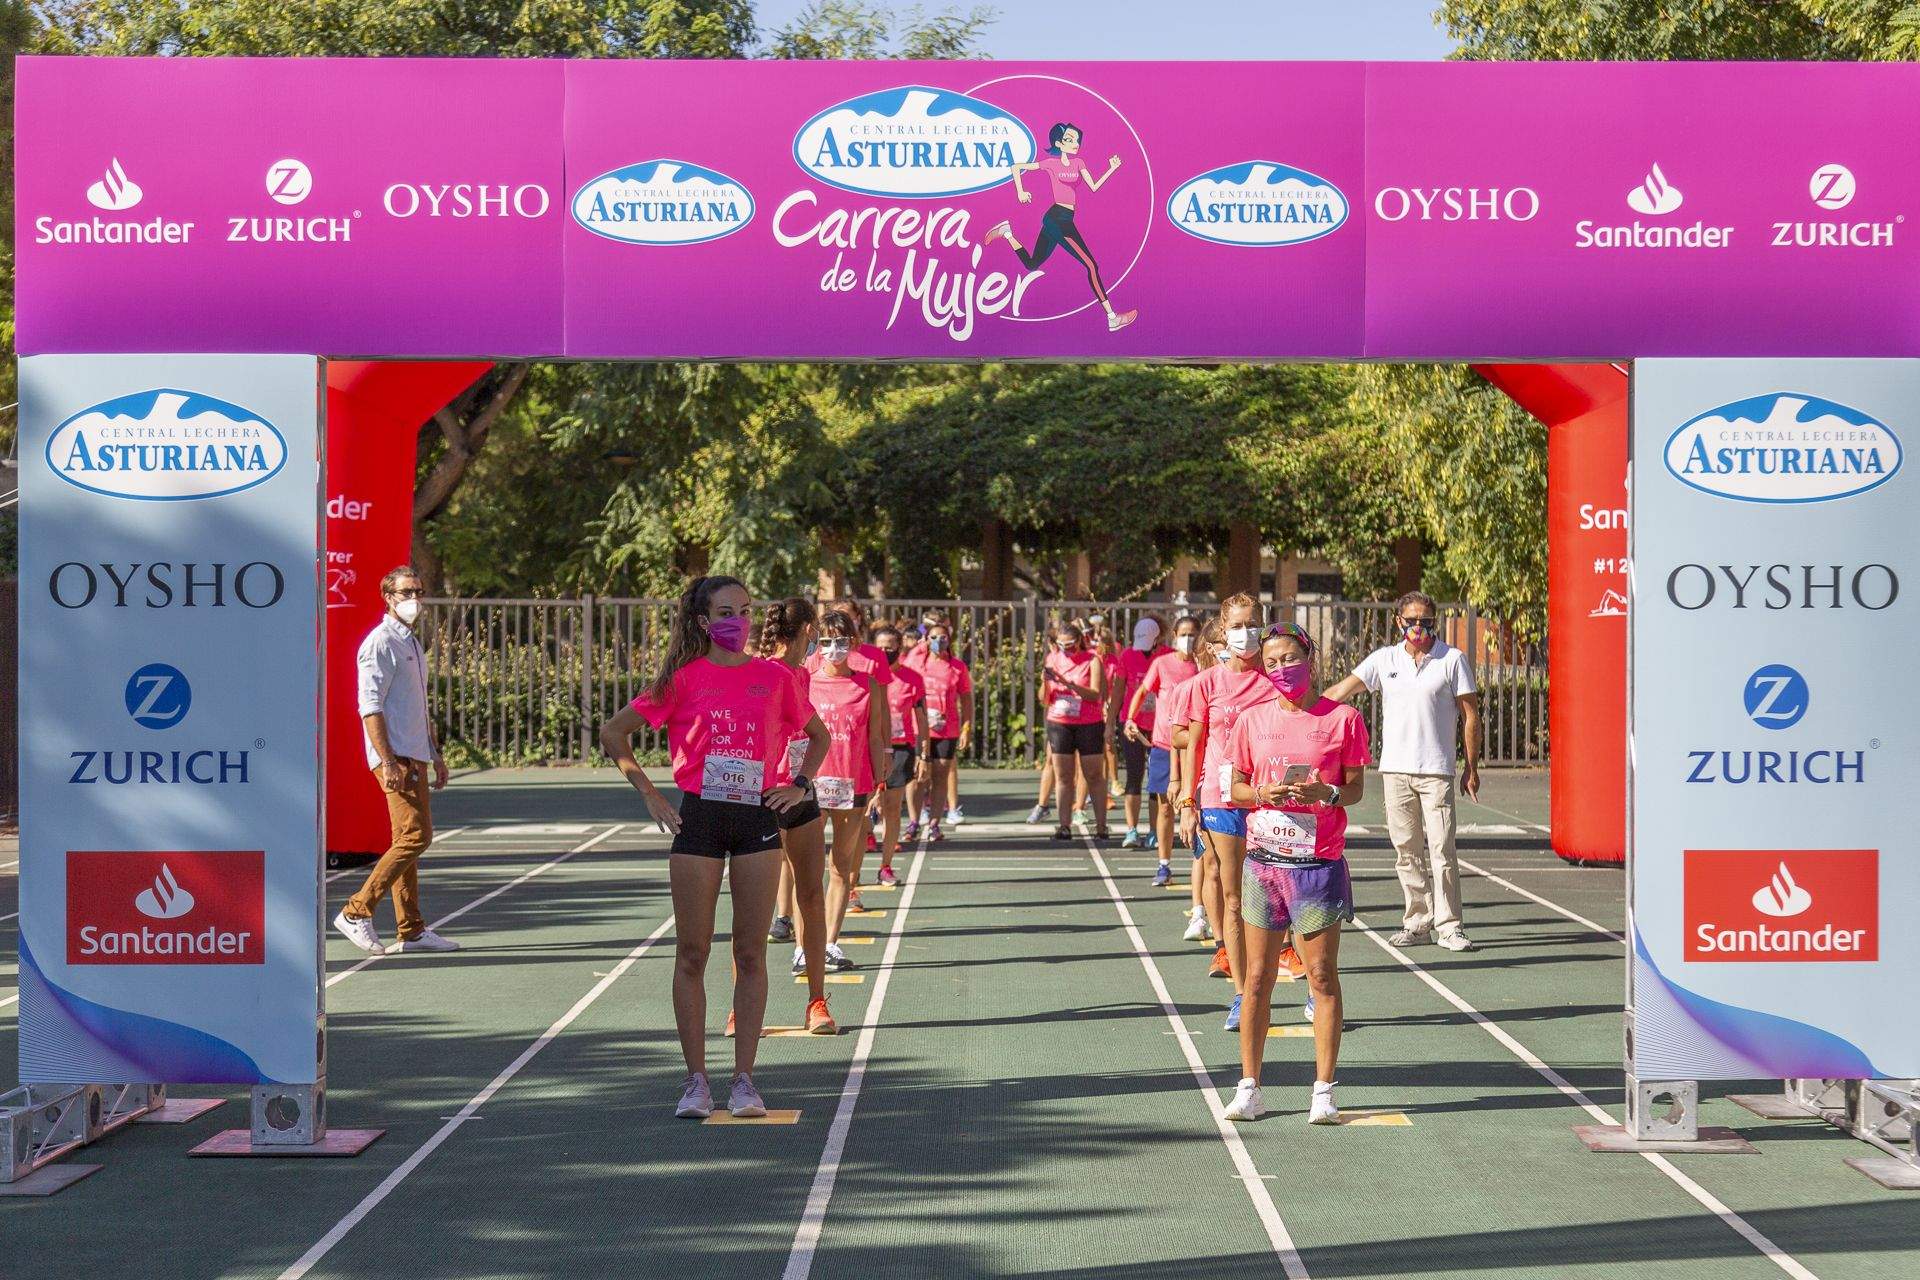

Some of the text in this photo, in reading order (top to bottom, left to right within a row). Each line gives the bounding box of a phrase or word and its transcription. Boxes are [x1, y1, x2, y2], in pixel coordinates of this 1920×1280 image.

[850, 125, 1010, 135] CENTRAL LECHERA
[813, 127, 1016, 168] ASTURIANA
[384, 184, 549, 218] OYSHO
[587, 190, 740, 223] ASTURIANA
[614, 189, 735, 198] CENTRAL LECHERA
[1209, 190, 1328, 200] CENTRAL LECHERA
[1375, 188, 1539, 221] OYSHO
[772, 190, 970, 248] Carrera
[1181, 192, 1334, 225] ASTURIANA
[35, 217, 194, 244] Santander
[1575, 221, 1734, 248] Santander
[820, 245, 1045, 341] de la Mujer
[100, 428, 261, 438] CENTRAL LECHERA
[1719, 431, 1878, 441] CENTRAL LECHERA
[63, 430, 270, 472] ASTURIANA
[1682, 433, 1886, 474] ASTURIANA
[48, 561, 285, 609] OYSHO
[1666, 563, 1900, 611] OYSHO
[710, 709, 732, 719] WE
[711, 736, 731, 745] FOR
[1268, 756, 1289, 767] WE
[722, 772, 746, 784] 016
[824, 787, 841, 796] 016
[1272, 826, 1297, 838] 016
[80, 925, 251, 955] Santander
[1696, 923, 1866, 952] Santander
